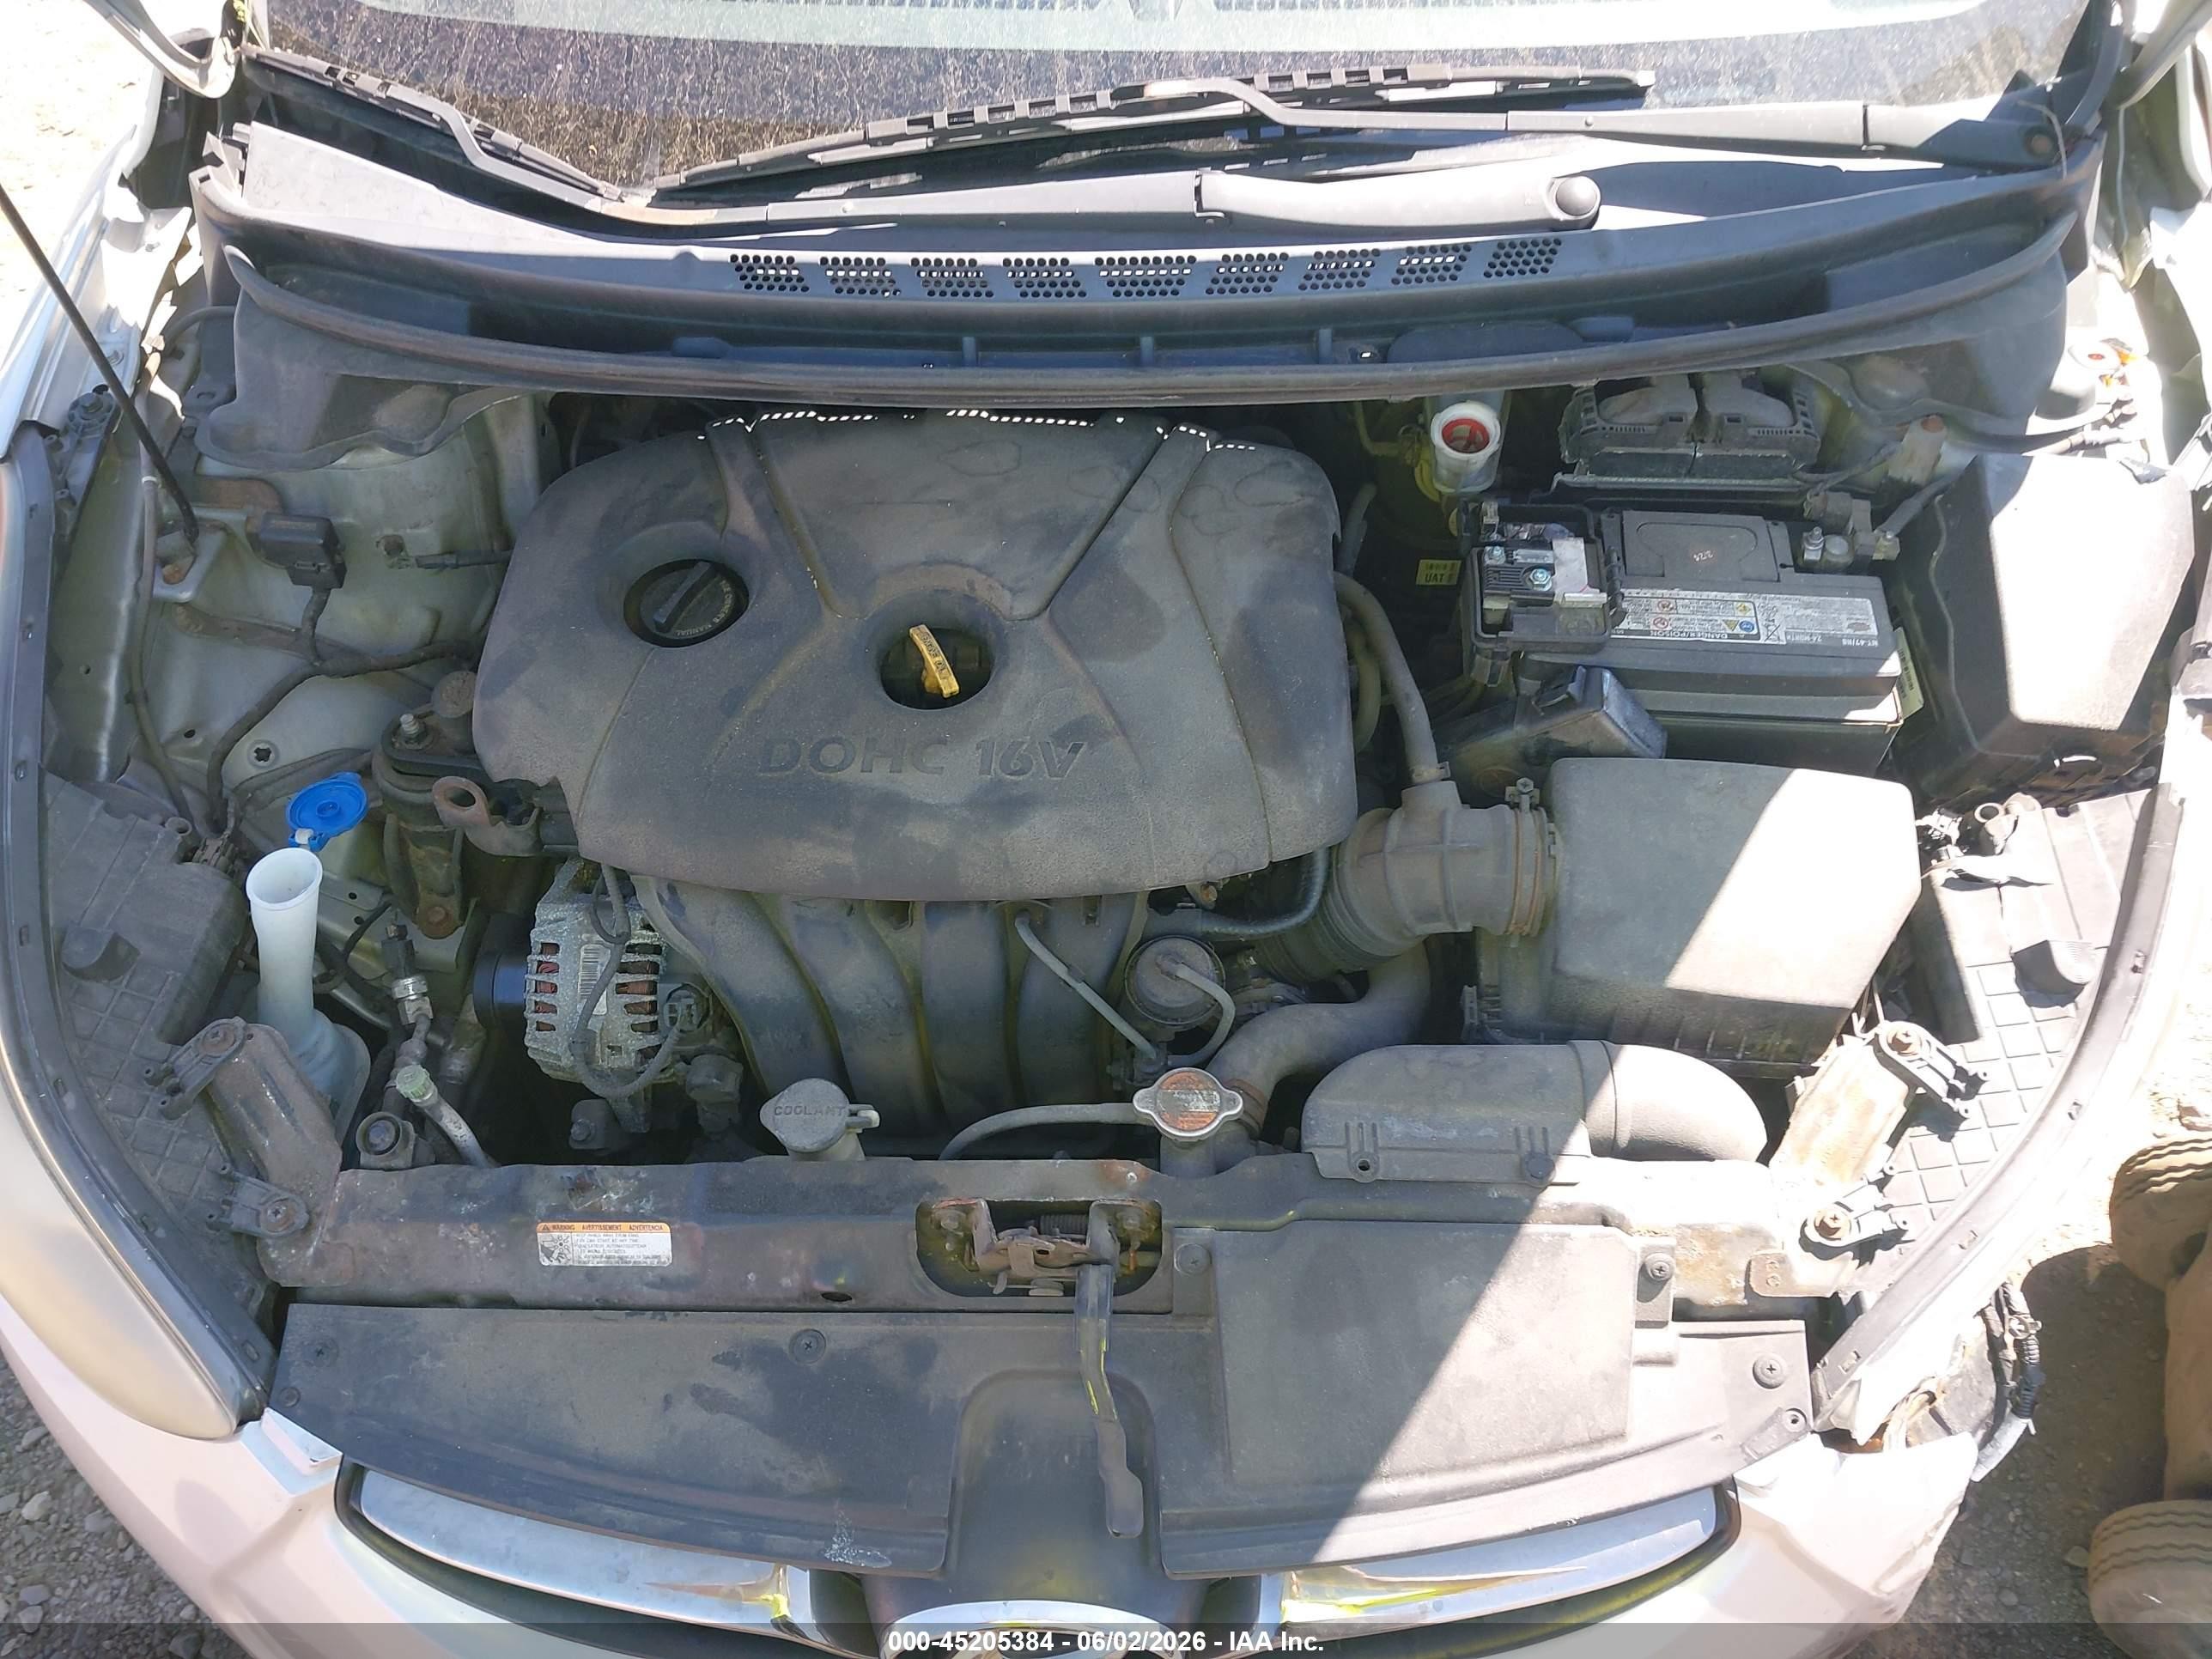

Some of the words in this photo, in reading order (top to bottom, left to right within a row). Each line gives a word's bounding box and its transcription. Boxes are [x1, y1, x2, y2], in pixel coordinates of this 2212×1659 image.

[762, 736, 949, 775] DOHC
[975, 739, 1087, 780] 16V
[775, 1104, 846, 1115] COOLANT
